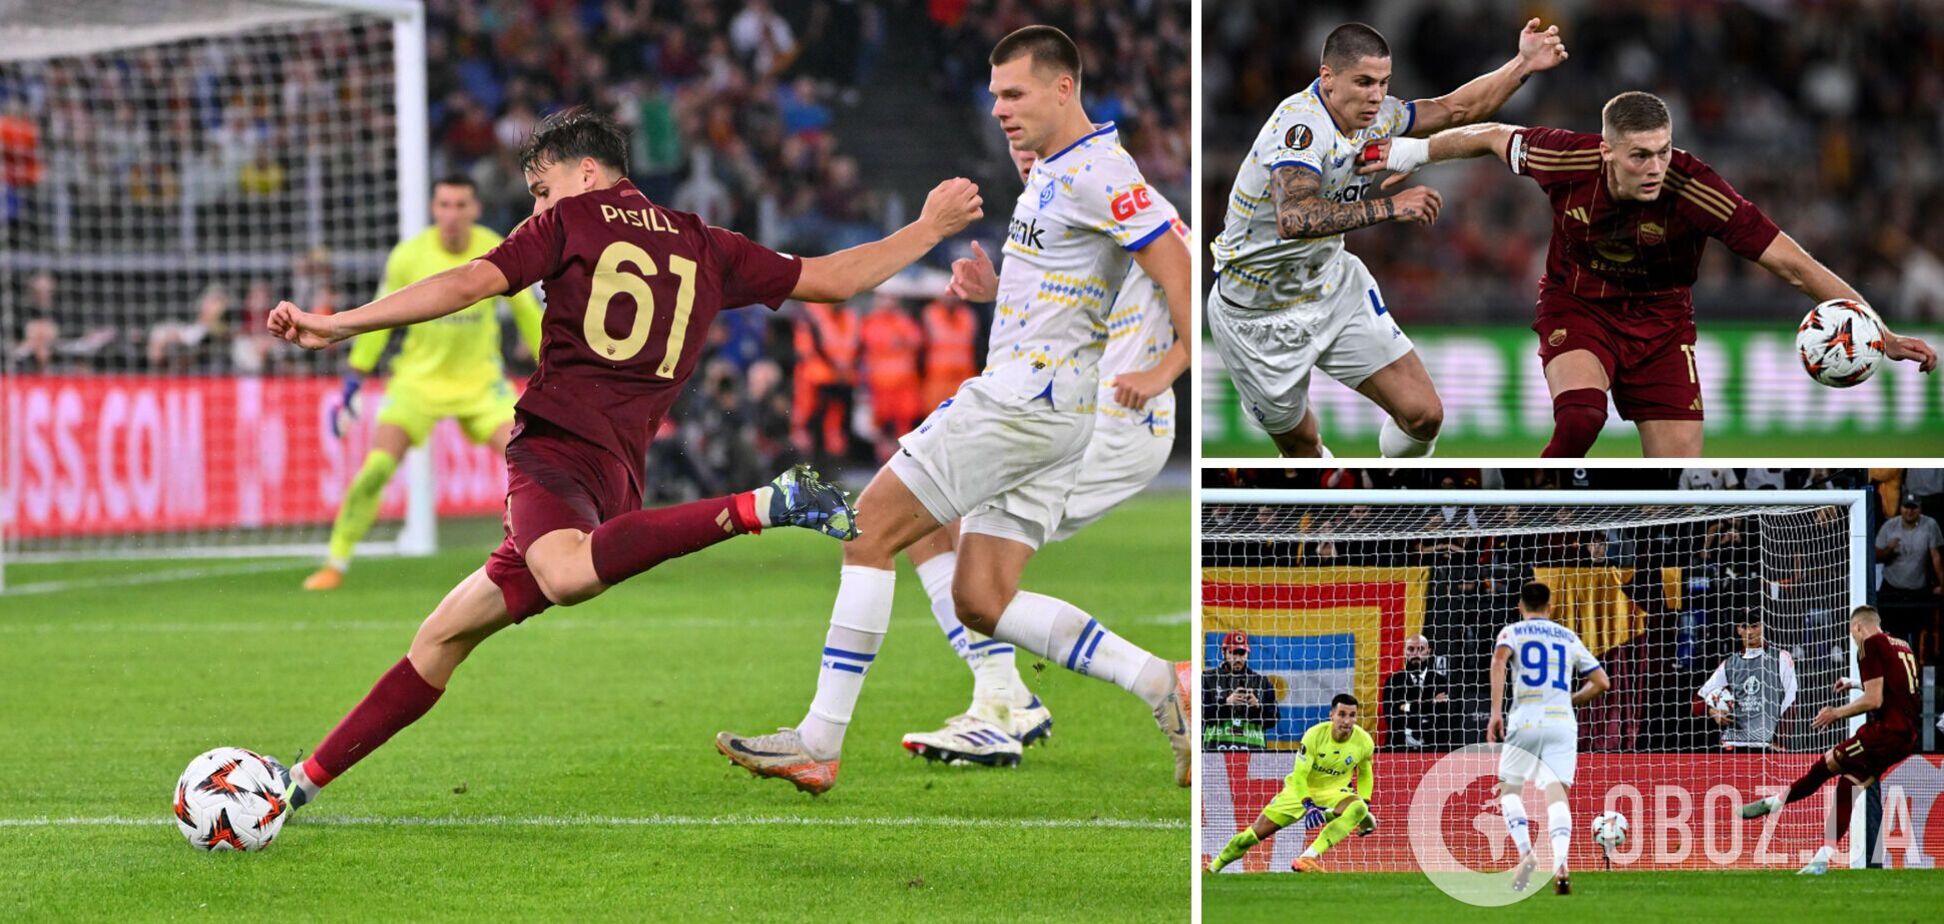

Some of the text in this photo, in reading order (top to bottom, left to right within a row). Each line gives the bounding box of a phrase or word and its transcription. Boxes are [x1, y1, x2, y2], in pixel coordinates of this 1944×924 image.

[583, 241, 697, 379] 61
[1520, 641, 1568, 691] 91
[1898, 651, 1920, 695] 11
[1845, 739, 1864, 758] 11
